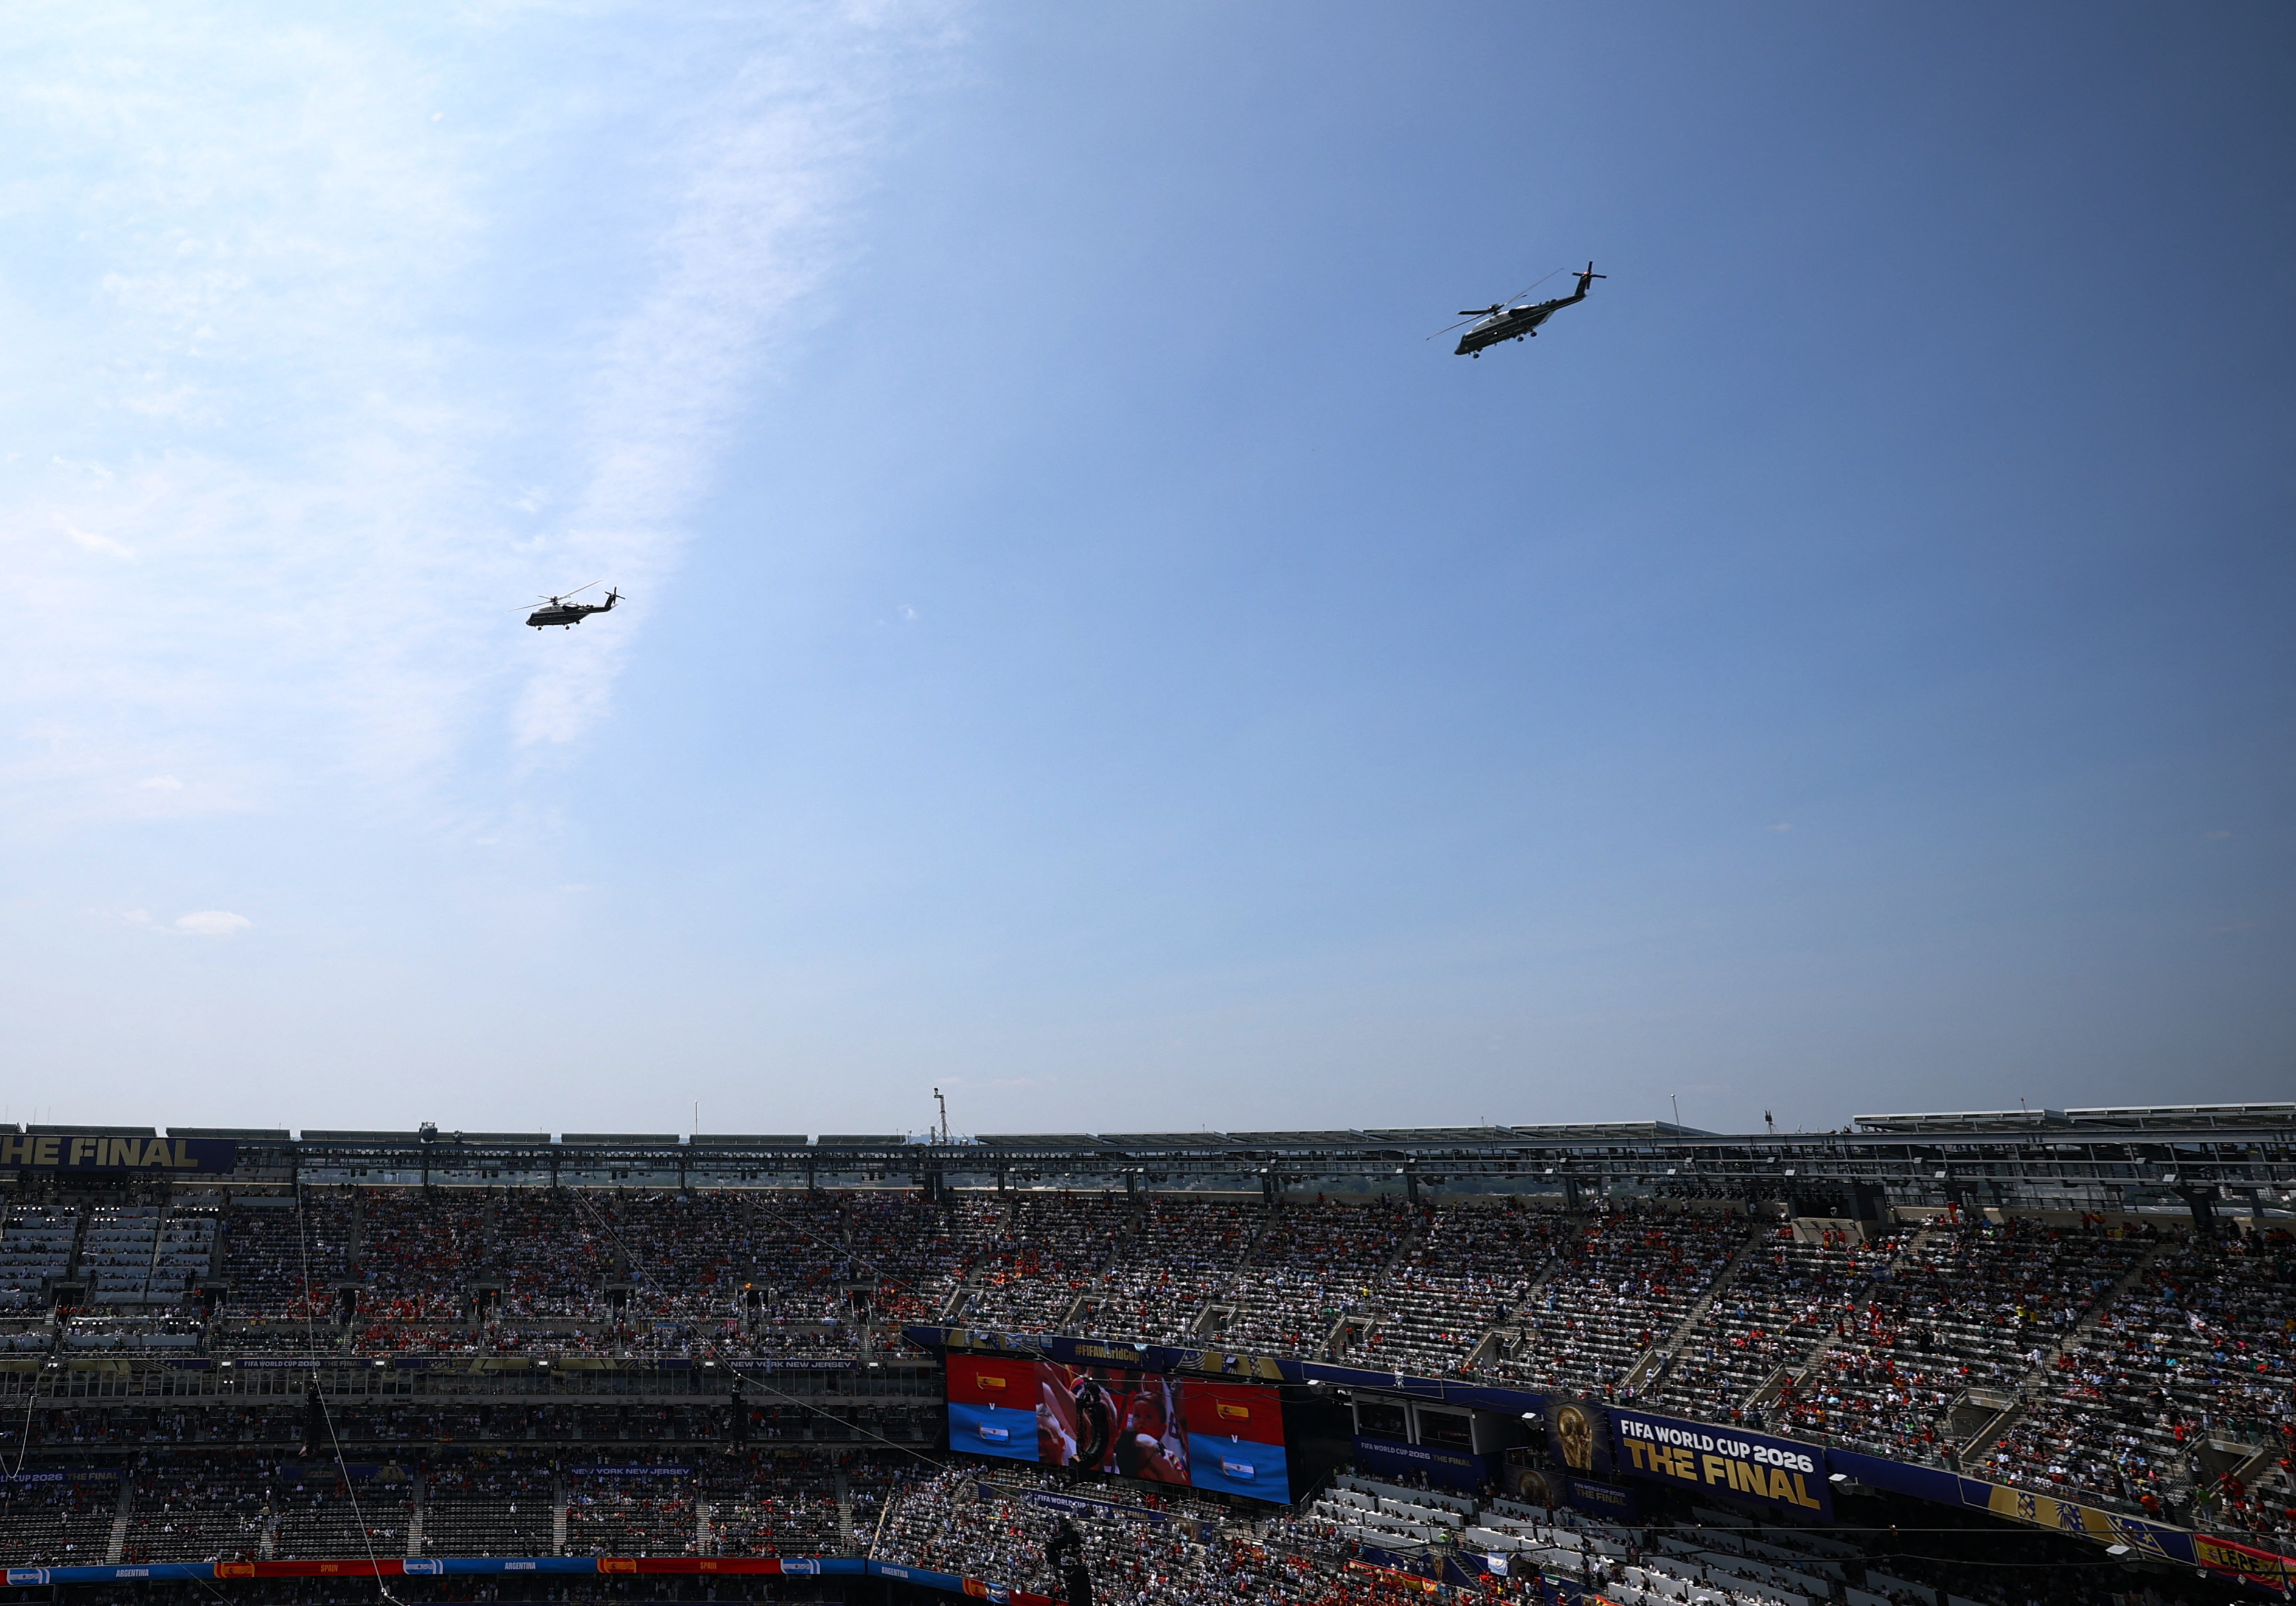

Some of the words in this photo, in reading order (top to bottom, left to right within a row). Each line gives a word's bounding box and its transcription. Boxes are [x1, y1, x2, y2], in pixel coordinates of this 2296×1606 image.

[0, 1136, 61, 1165] HE
[69, 1138, 198, 1167] FINAL
[1620, 1419, 1655, 1441] FIFA
[1654, 1425, 1714, 1452] WORLD
[1716, 1438, 1751, 1459] CUP
[1753, 1445, 1815, 1473] 2026
[1361, 1442, 1374, 1450] FIFA
[1374, 1444, 1396, 1454] WORLD
[1396, 1448, 1408, 1456] CUP
[1408, 1450, 1431, 1460] 2026
[1432, 1454, 1448, 1463] THE
[1449, 1456, 1472, 1467] FINAL
[13, 1474, 31, 1483] CUP
[32, 1473, 63, 1483] 2026
[1623, 1437, 1699, 1481] THE
[1702, 1454, 1821, 1510] FINAL
[1576, 1487, 1595, 1500] THE
[1596, 1492, 1627, 1506] FINAL
[1038, 1495, 1051, 1503] FIFA
[1051, 1496, 1073, 1507] WORLD
[1127, 1510, 1150, 1520] FINAL
[116, 1568, 149, 1577] ARGENTINA
[321, 1564, 338, 1573] SPAIN
[504, 1562, 536, 1571] ARGENTINA
[700, 1562, 717, 1570] SPAIN
[881, 1565, 909, 1579] ARGENTINA
